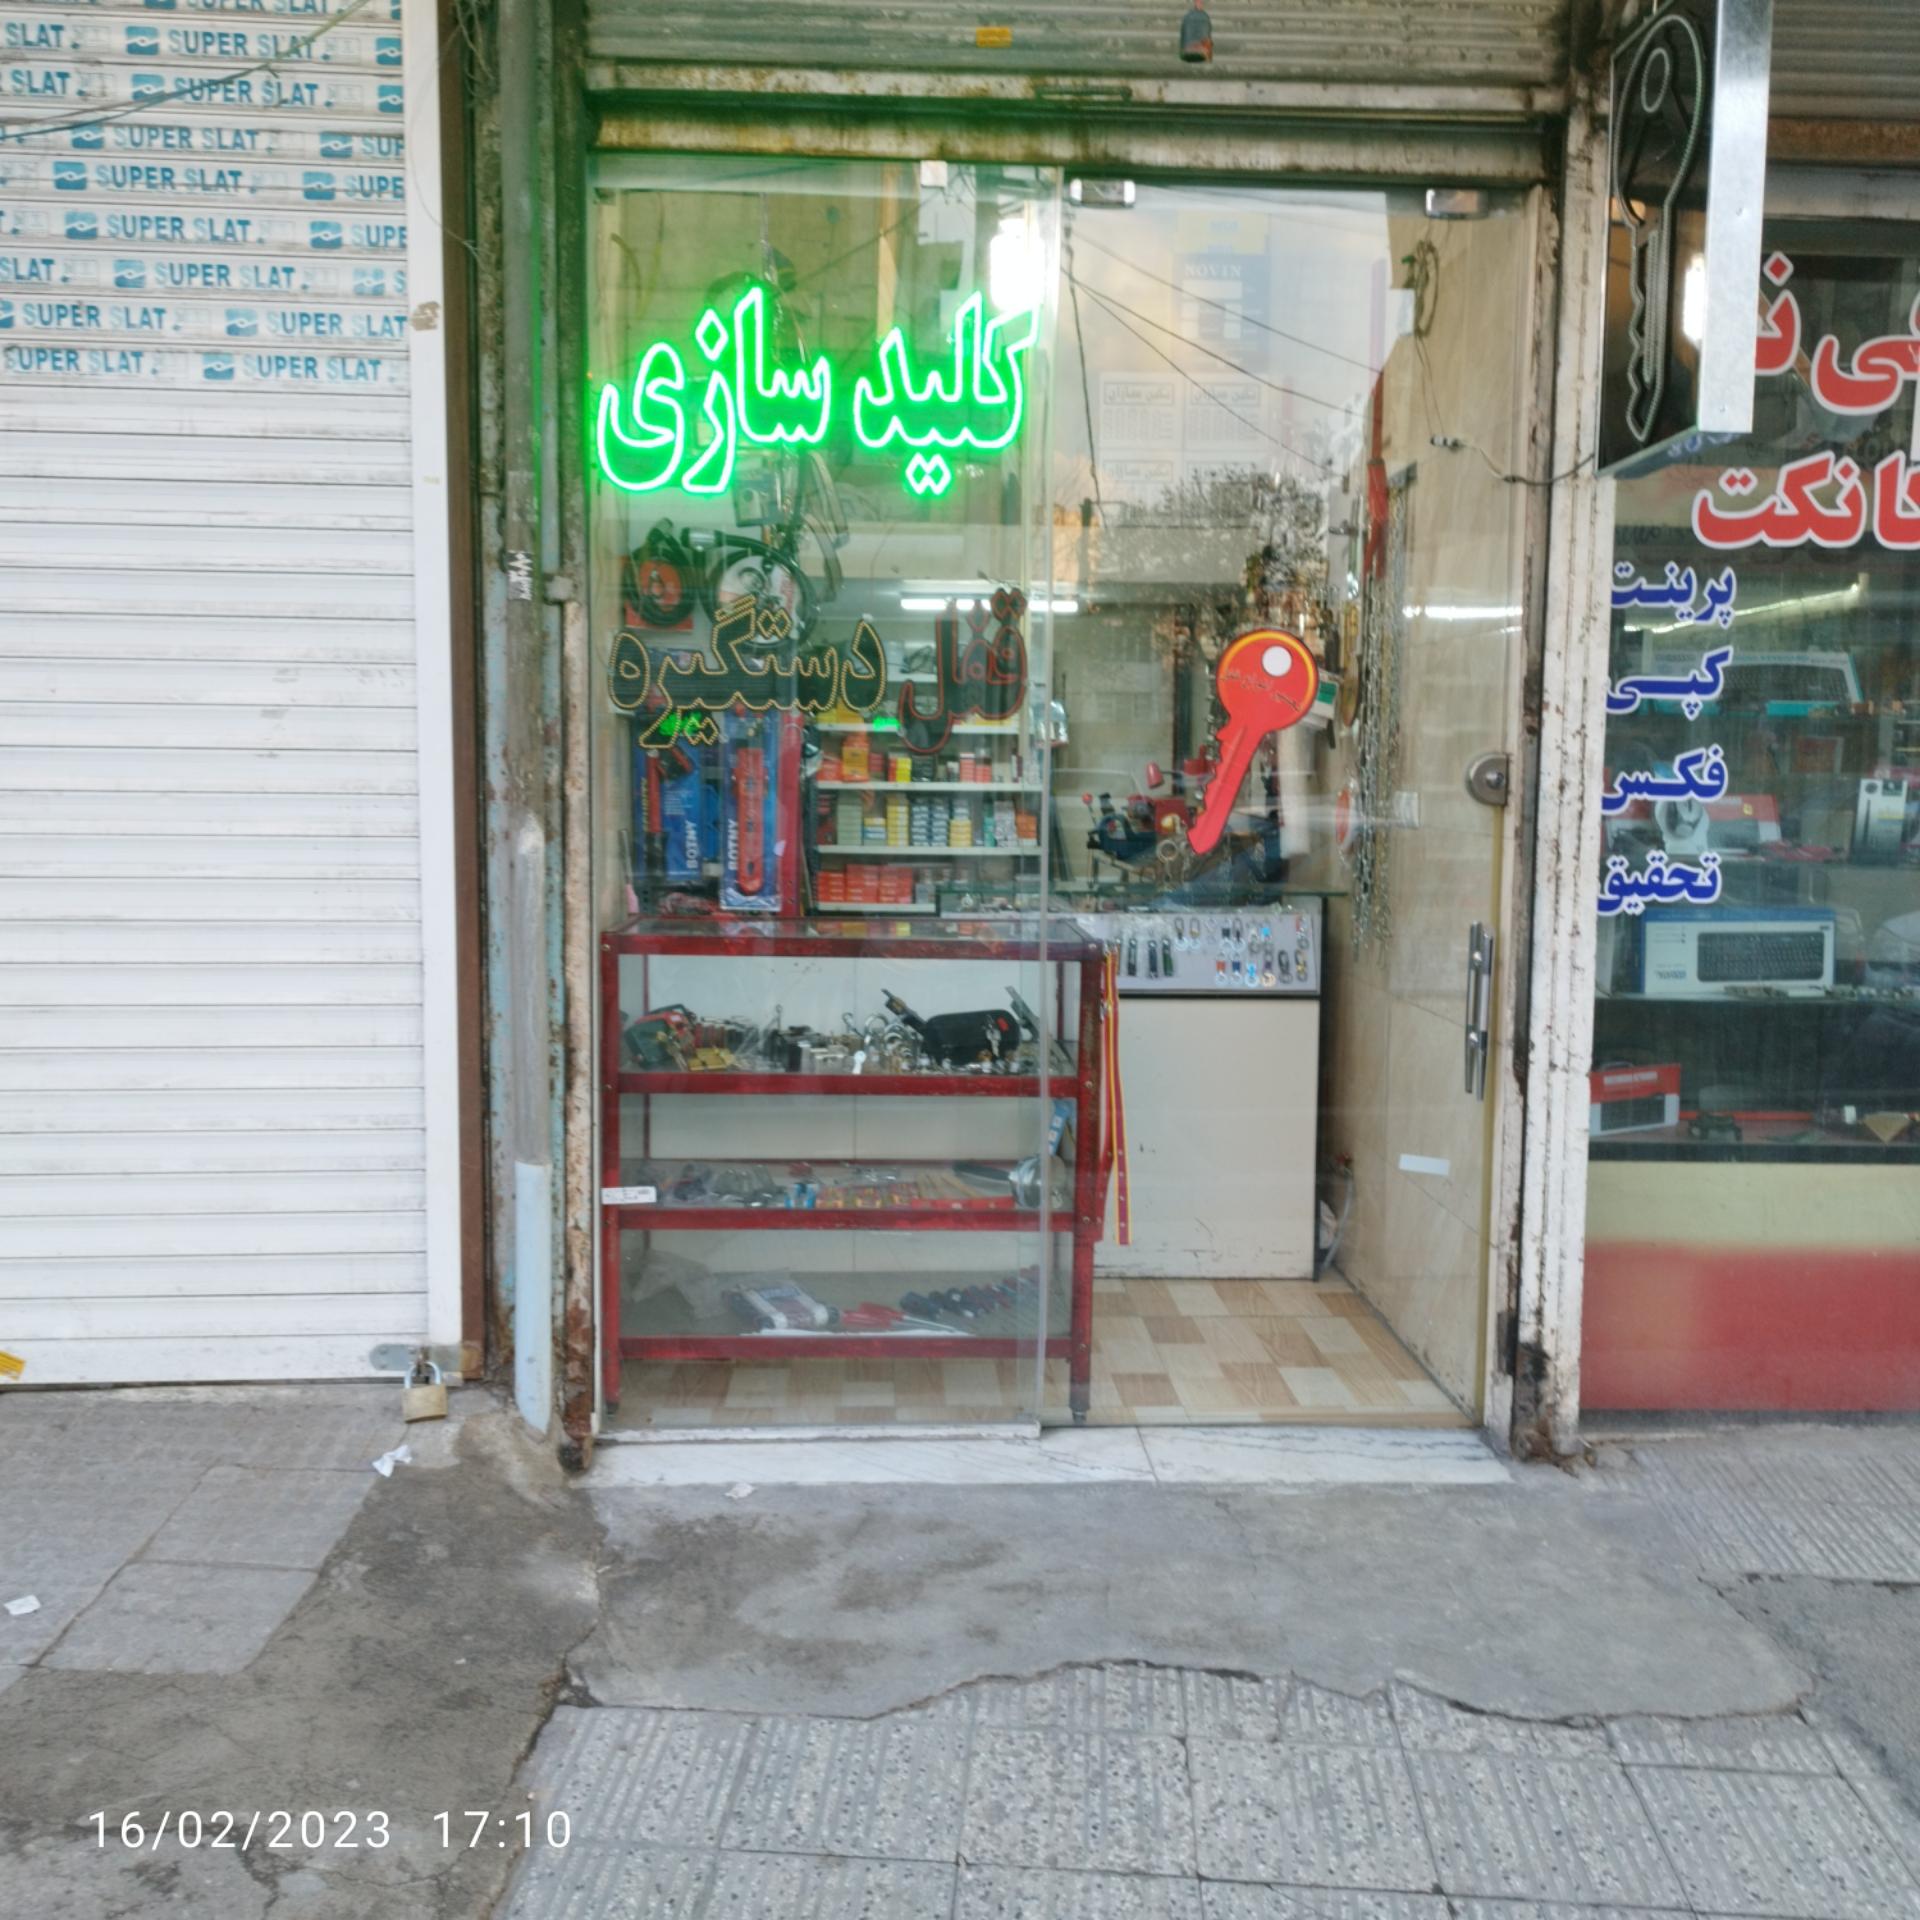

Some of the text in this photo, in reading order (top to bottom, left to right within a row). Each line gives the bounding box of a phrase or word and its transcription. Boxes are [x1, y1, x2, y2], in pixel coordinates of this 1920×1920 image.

[6, 22, 64, 48] SLAT
[168, 29, 316, 60] SUPER SLAT
[12, 69, 70, 95] SLAT
[174, 77, 318, 106] SUPER SLAT
[113, 125, 259, 151] SUPER SLAT
[96, 164, 242, 193] SUPER SLAT
[107, 213, 252, 244] SUPER SLAT
[155, 261, 295, 290] SUPER SLAT
[23, 303, 167, 331] SUPER SLAT
[267, 310, 408, 338] SUPER SLAT
[4, 346, 144, 374] SUPER SLAT
[244, 354, 382, 382] SUPER SLAT
[598, 287, 1040, 494] کلید سازی
[1611, 562, 1737, 629] پرینت
[608, 587, 1028, 754] قفل دستگیره
[1605, 646, 1734, 721] کپی
[1601, 743, 1729, 816] فکس
[1597, 851, 1722, 915] تحقیق
